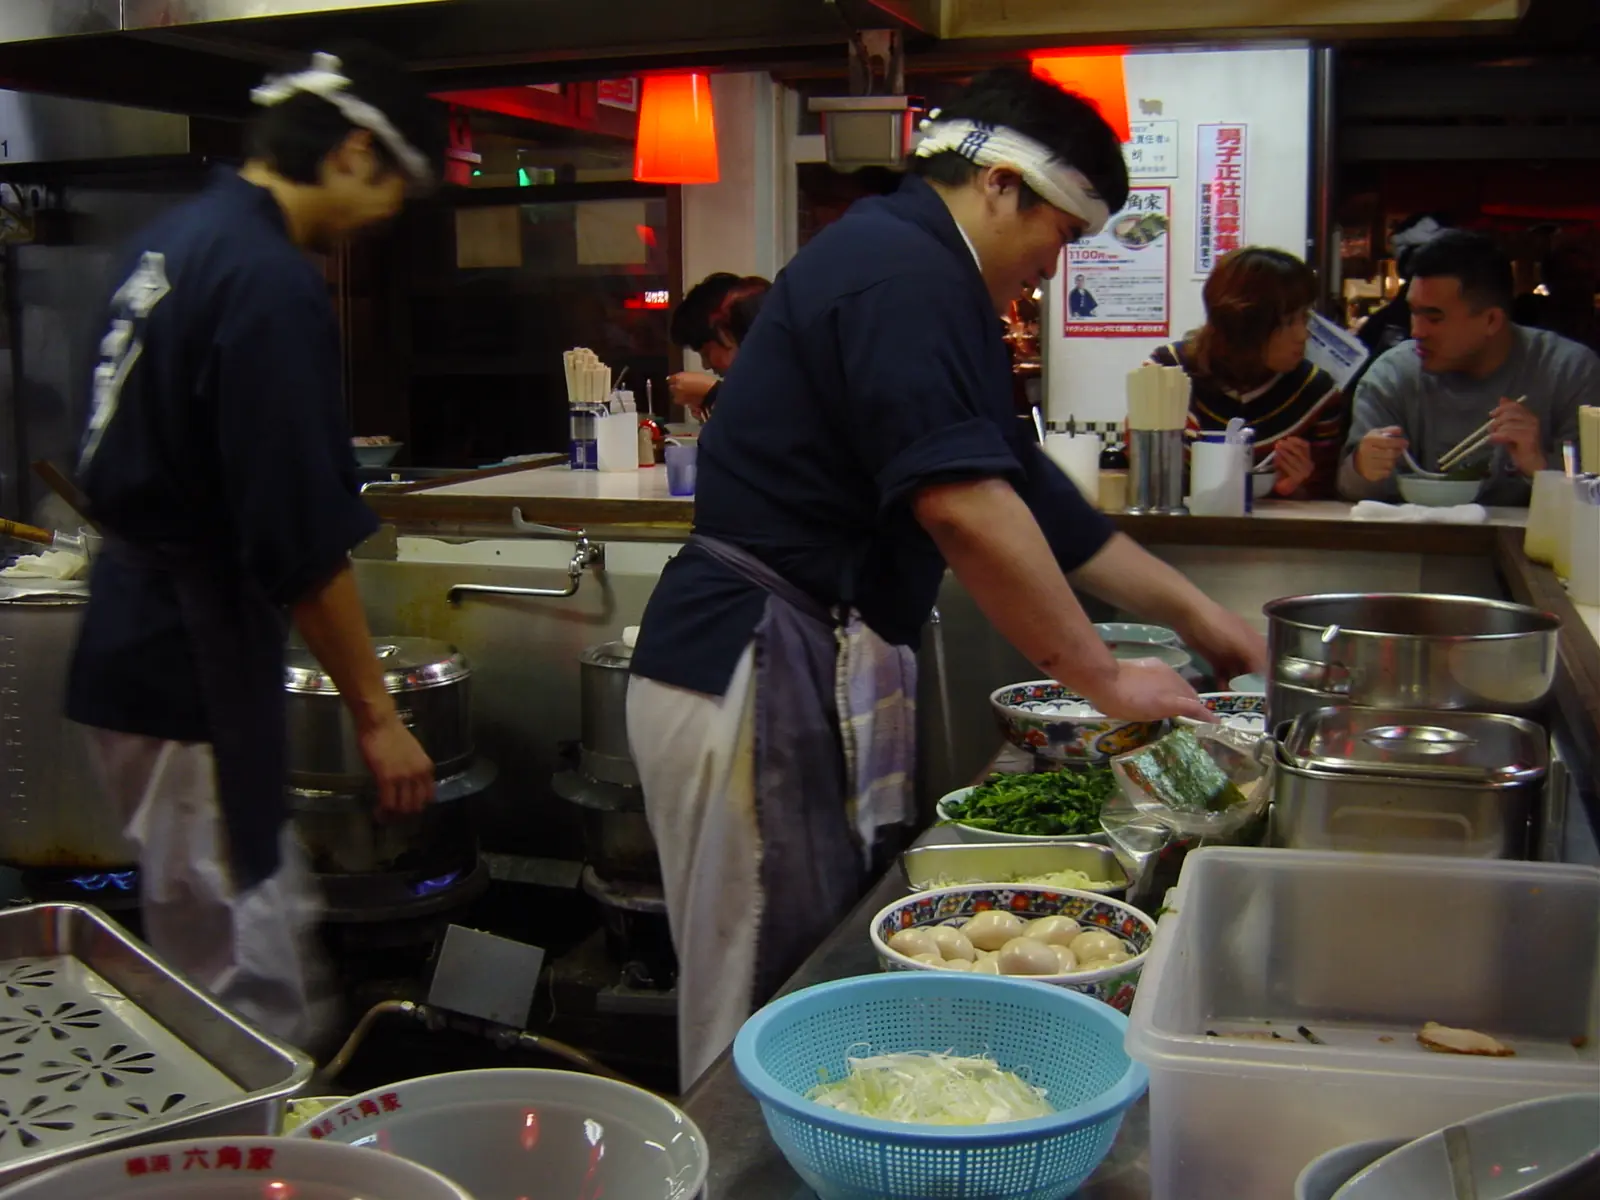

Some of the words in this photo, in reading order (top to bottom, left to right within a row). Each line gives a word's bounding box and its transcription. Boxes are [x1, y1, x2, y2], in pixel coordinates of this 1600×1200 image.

[1214, 128, 1241, 262] 男子正社員募集
[182, 1146, 275, 1171] 六角家
